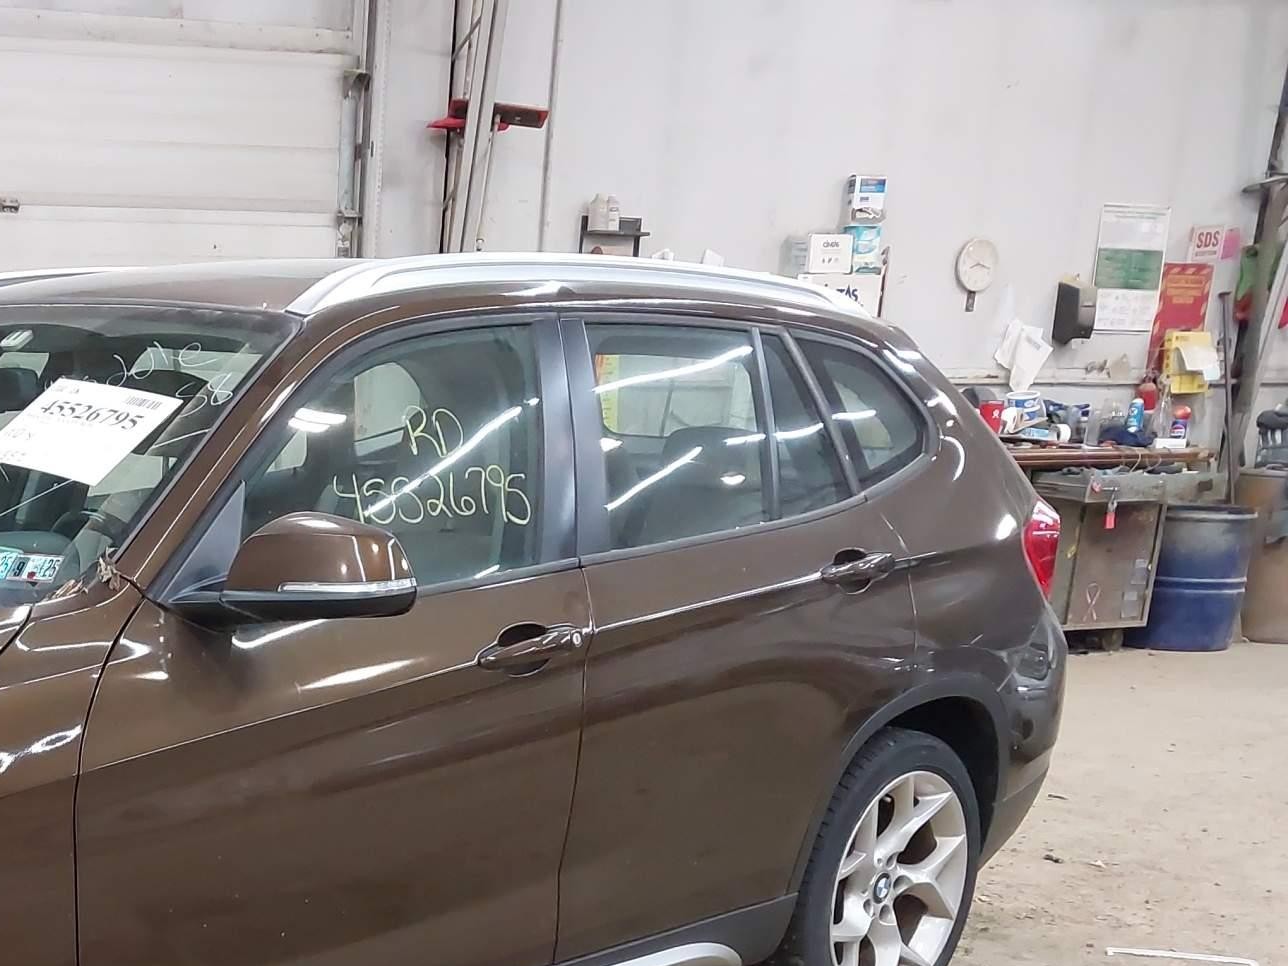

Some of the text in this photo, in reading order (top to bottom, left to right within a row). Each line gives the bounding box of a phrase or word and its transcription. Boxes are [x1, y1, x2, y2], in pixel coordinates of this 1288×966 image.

[1196, 230, 1220, 249] SDS
[40, 398, 145, 431] 45526795
[404, 405, 464, 458] RD
[332, 464, 532, 526] 45526795
